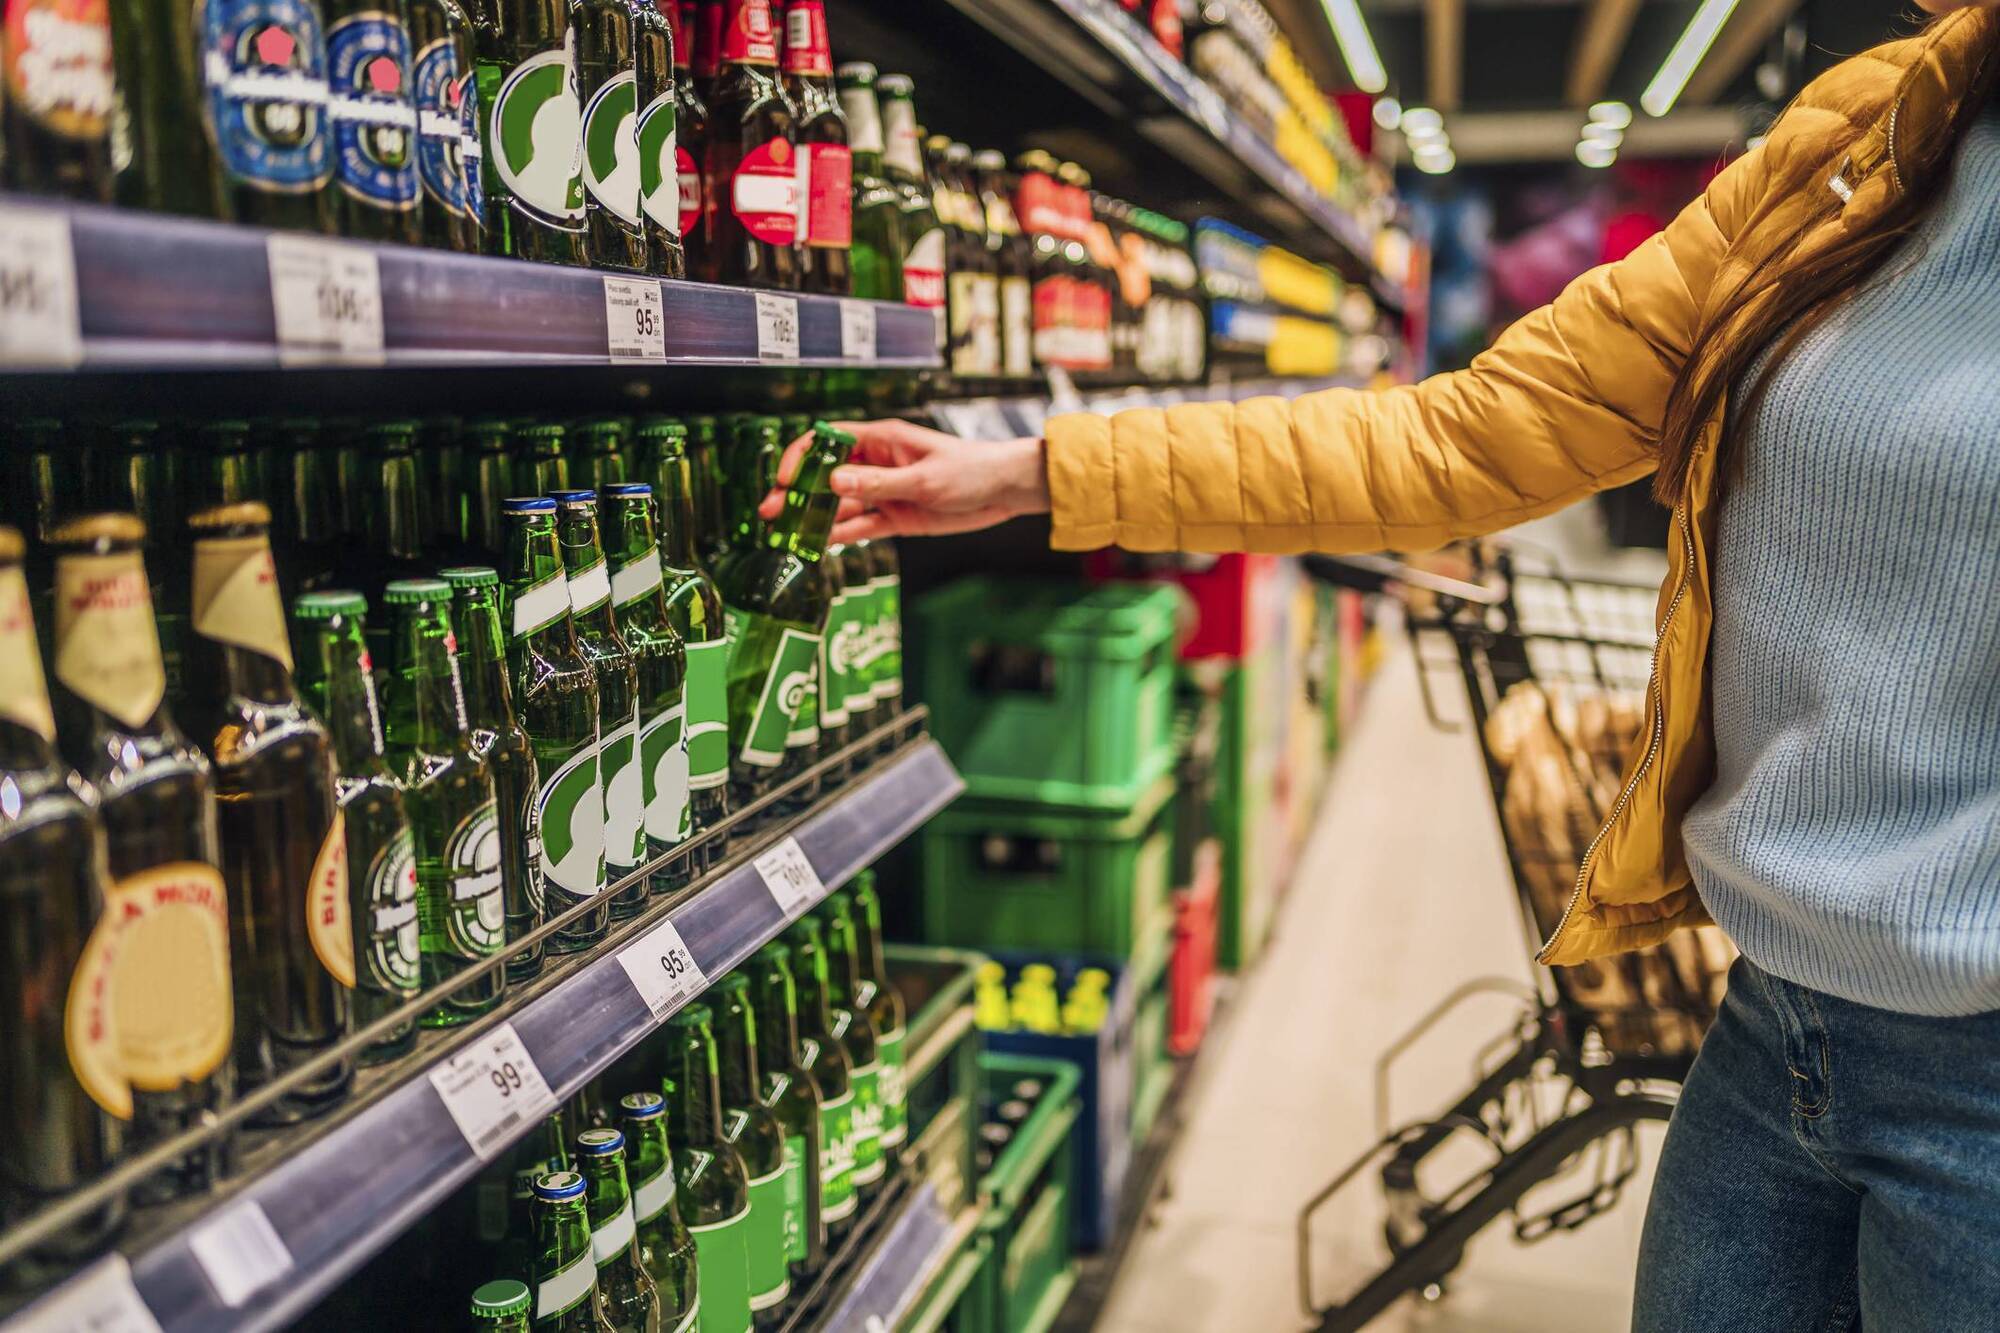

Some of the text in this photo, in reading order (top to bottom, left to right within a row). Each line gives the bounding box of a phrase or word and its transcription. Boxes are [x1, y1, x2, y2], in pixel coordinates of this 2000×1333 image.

[636, 308, 653, 336] 95
[661, 949, 685, 980] 95
[491, 1062, 521, 1097] 99
